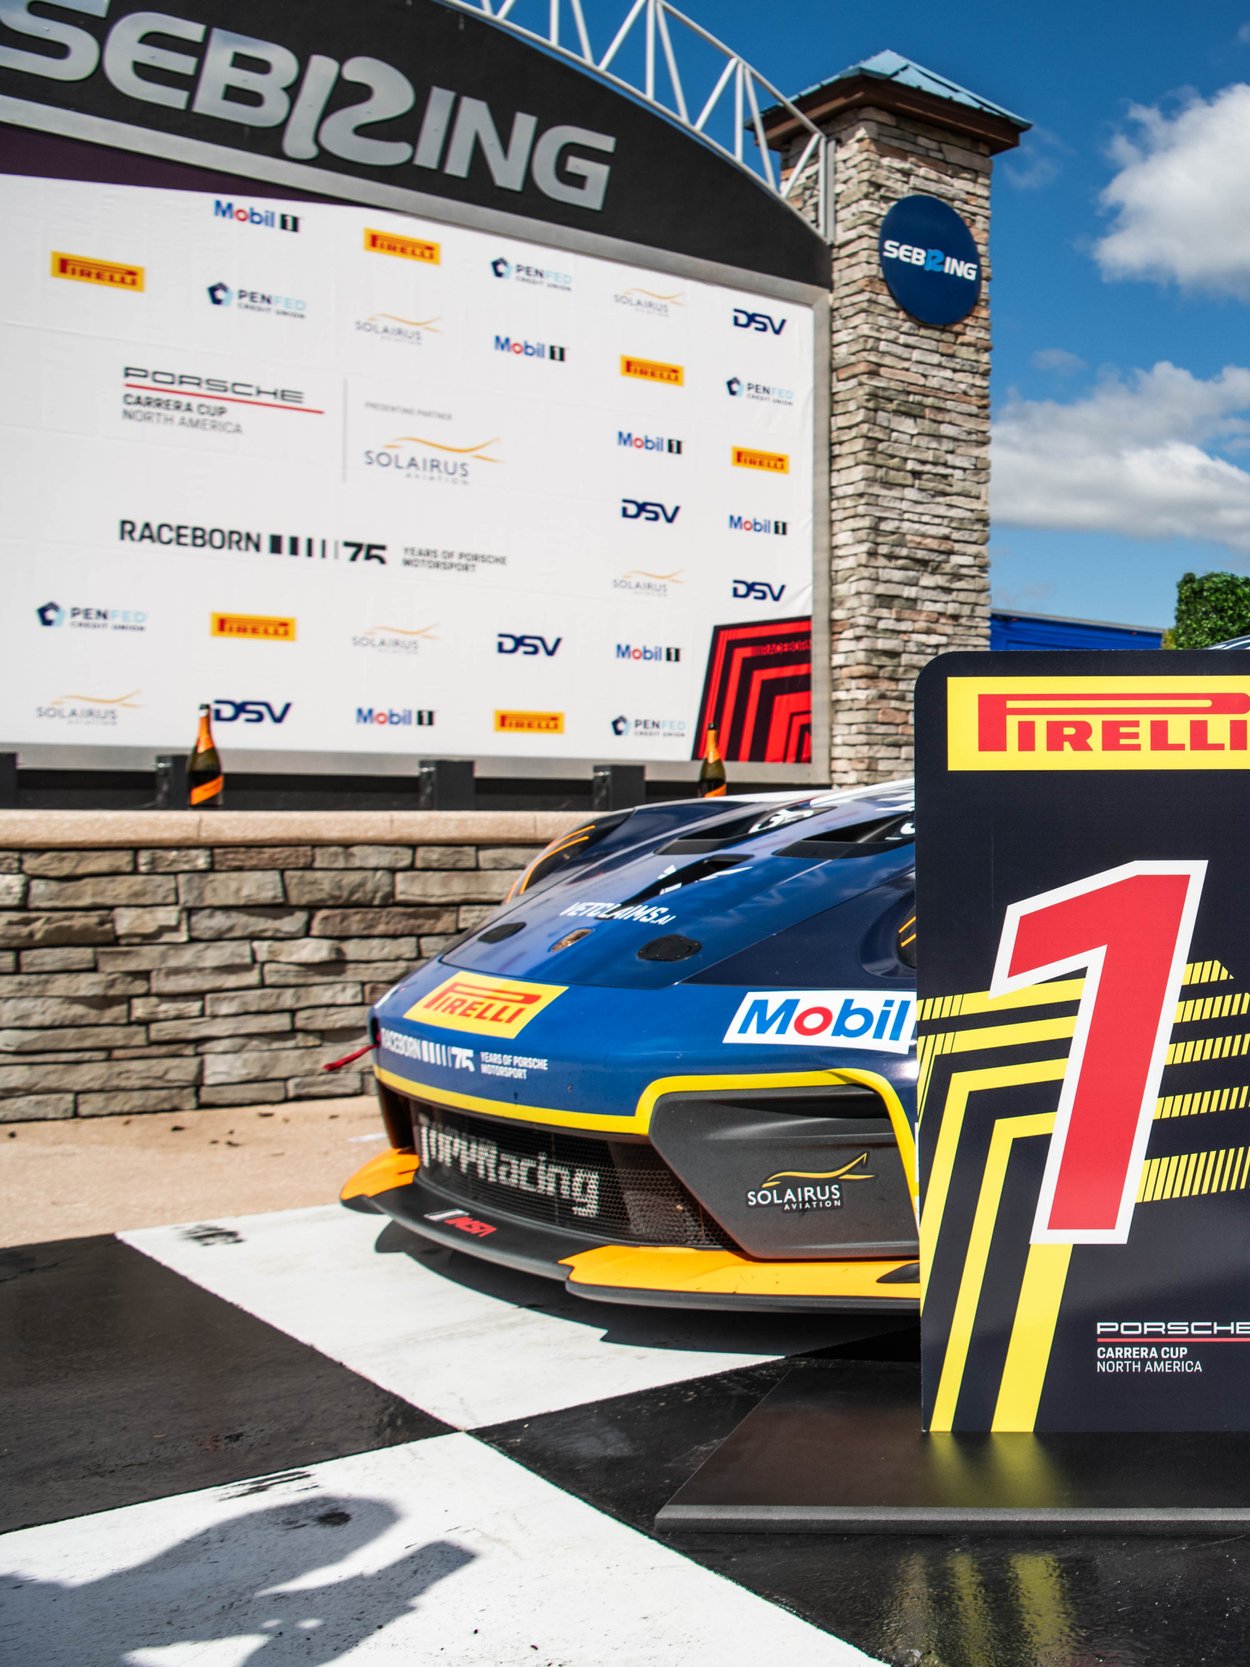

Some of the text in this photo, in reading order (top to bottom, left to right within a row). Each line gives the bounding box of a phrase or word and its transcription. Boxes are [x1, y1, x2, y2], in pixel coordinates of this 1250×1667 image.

[0, 0, 616, 211] SEBRING
[214, 199, 298, 232] Mobil 1
[370, 234, 434, 260] PIRELLI
[883, 240, 978, 281] SEBRING
[59, 257, 138, 287] PIRELLI
[516, 264, 572, 284] PENFED
[238, 288, 307, 311] PENFED
[614, 294, 668, 313] SOLAIRUS
[355, 320, 423, 342] SOLAIRUS
[733, 308, 787, 336] DSV
[494, 335, 564, 362] Mobil 1
[625, 360, 680, 382] PIRELLI
[122, 366, 305, 404] PORSCHE
[746, 382, 794, 399] PENFED
[122, 393, 228, 417] CARRERA CUP
[122, 407, 243, 434] NORTH AMERICA
[618, 431, 680, 454] Mobil 1
[364, 449, 470, 478] SOLAIRUS
[736, 450, 785, 471] PIRELLI
[621, 498, 681, 524] DSV
[728, 515, 786, 535] Mobil 1
[119, 519, 387, 566] RACEBORN 75
[612, 579, 668, 593] SOLAIRUS
[732, 580, 786, 602] DSV
[70, 606, 147, 624] PENFED
[218, 617, 289, 637] PIRELLI
[352, 636, 418, 650] SOLAIRUS
[496, 633, 562, 657] DSV
[616, 644, 680, 662] Mobil 1
[36, 706, 117, 720] SOLAIRUS
[214, 699, 293, 724] DSV
[356, 707, 433, 726] Mobil 1
[500, 714, 560, 730] PIRELLI
[634, 719, 686, 731] PENFED
[422, 982, 542, 1024] PIRELLI
[737, 998, 911, 1042] Mobil
[380, 1028, 476, 1073] RACEBORN 75
[480, 1052, 548, 1070] YEARS OF PORSCHE
[989, 860, 1208, 1244] 1
[480, 1064, 527, 1080] MOTORSPORT
[747, 1184, 840, 1206] SOLAIRUS
[784, 1200, 842, 1211] AVIATION
[1096, 1347, 1188, 1360] CARRERA CUP
[1096, 1360, 1202, 1373] NORTH AMERICA
